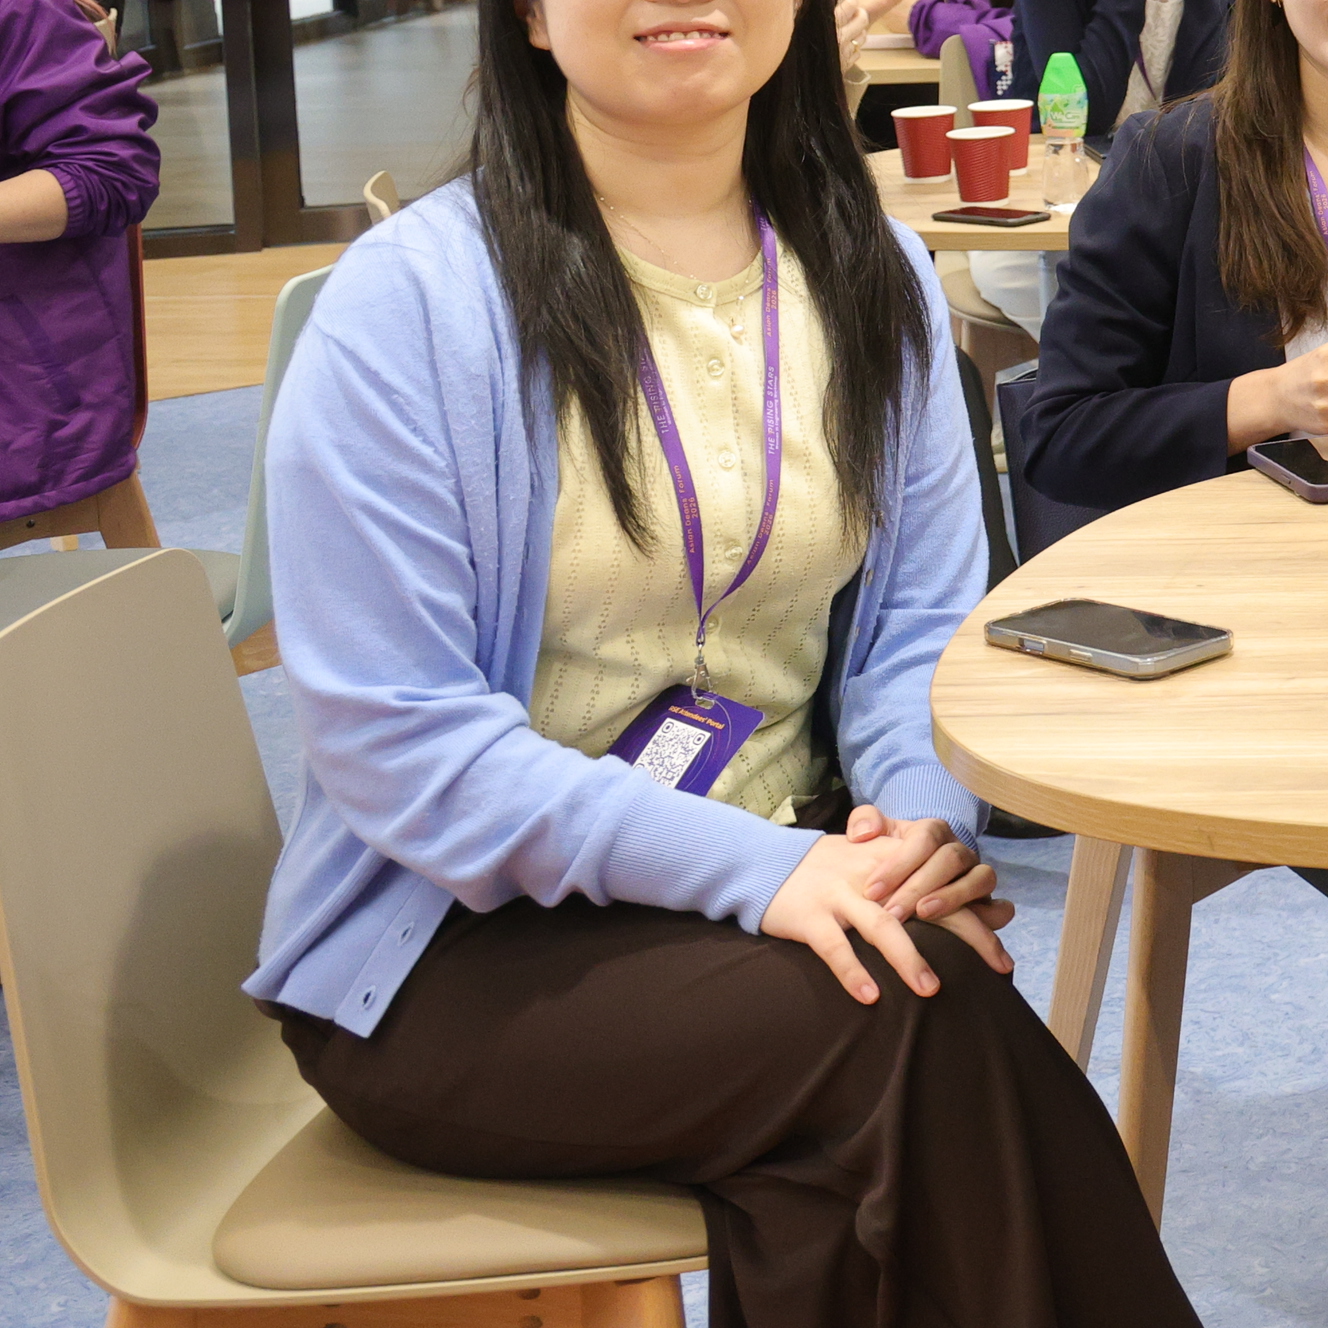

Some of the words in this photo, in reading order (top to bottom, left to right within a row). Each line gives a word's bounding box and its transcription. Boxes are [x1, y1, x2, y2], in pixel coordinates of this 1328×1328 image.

[767, 366, 775, 397] STARS
[656, 414, 670, 434] THE
[768, 438, 776, 455] THE
[674, 465, 686, 494] Forum
[688, 496, 698, 519] 2026
[687, 528, 696, 554] Asian
[706, 718, 726, 730] Portal
